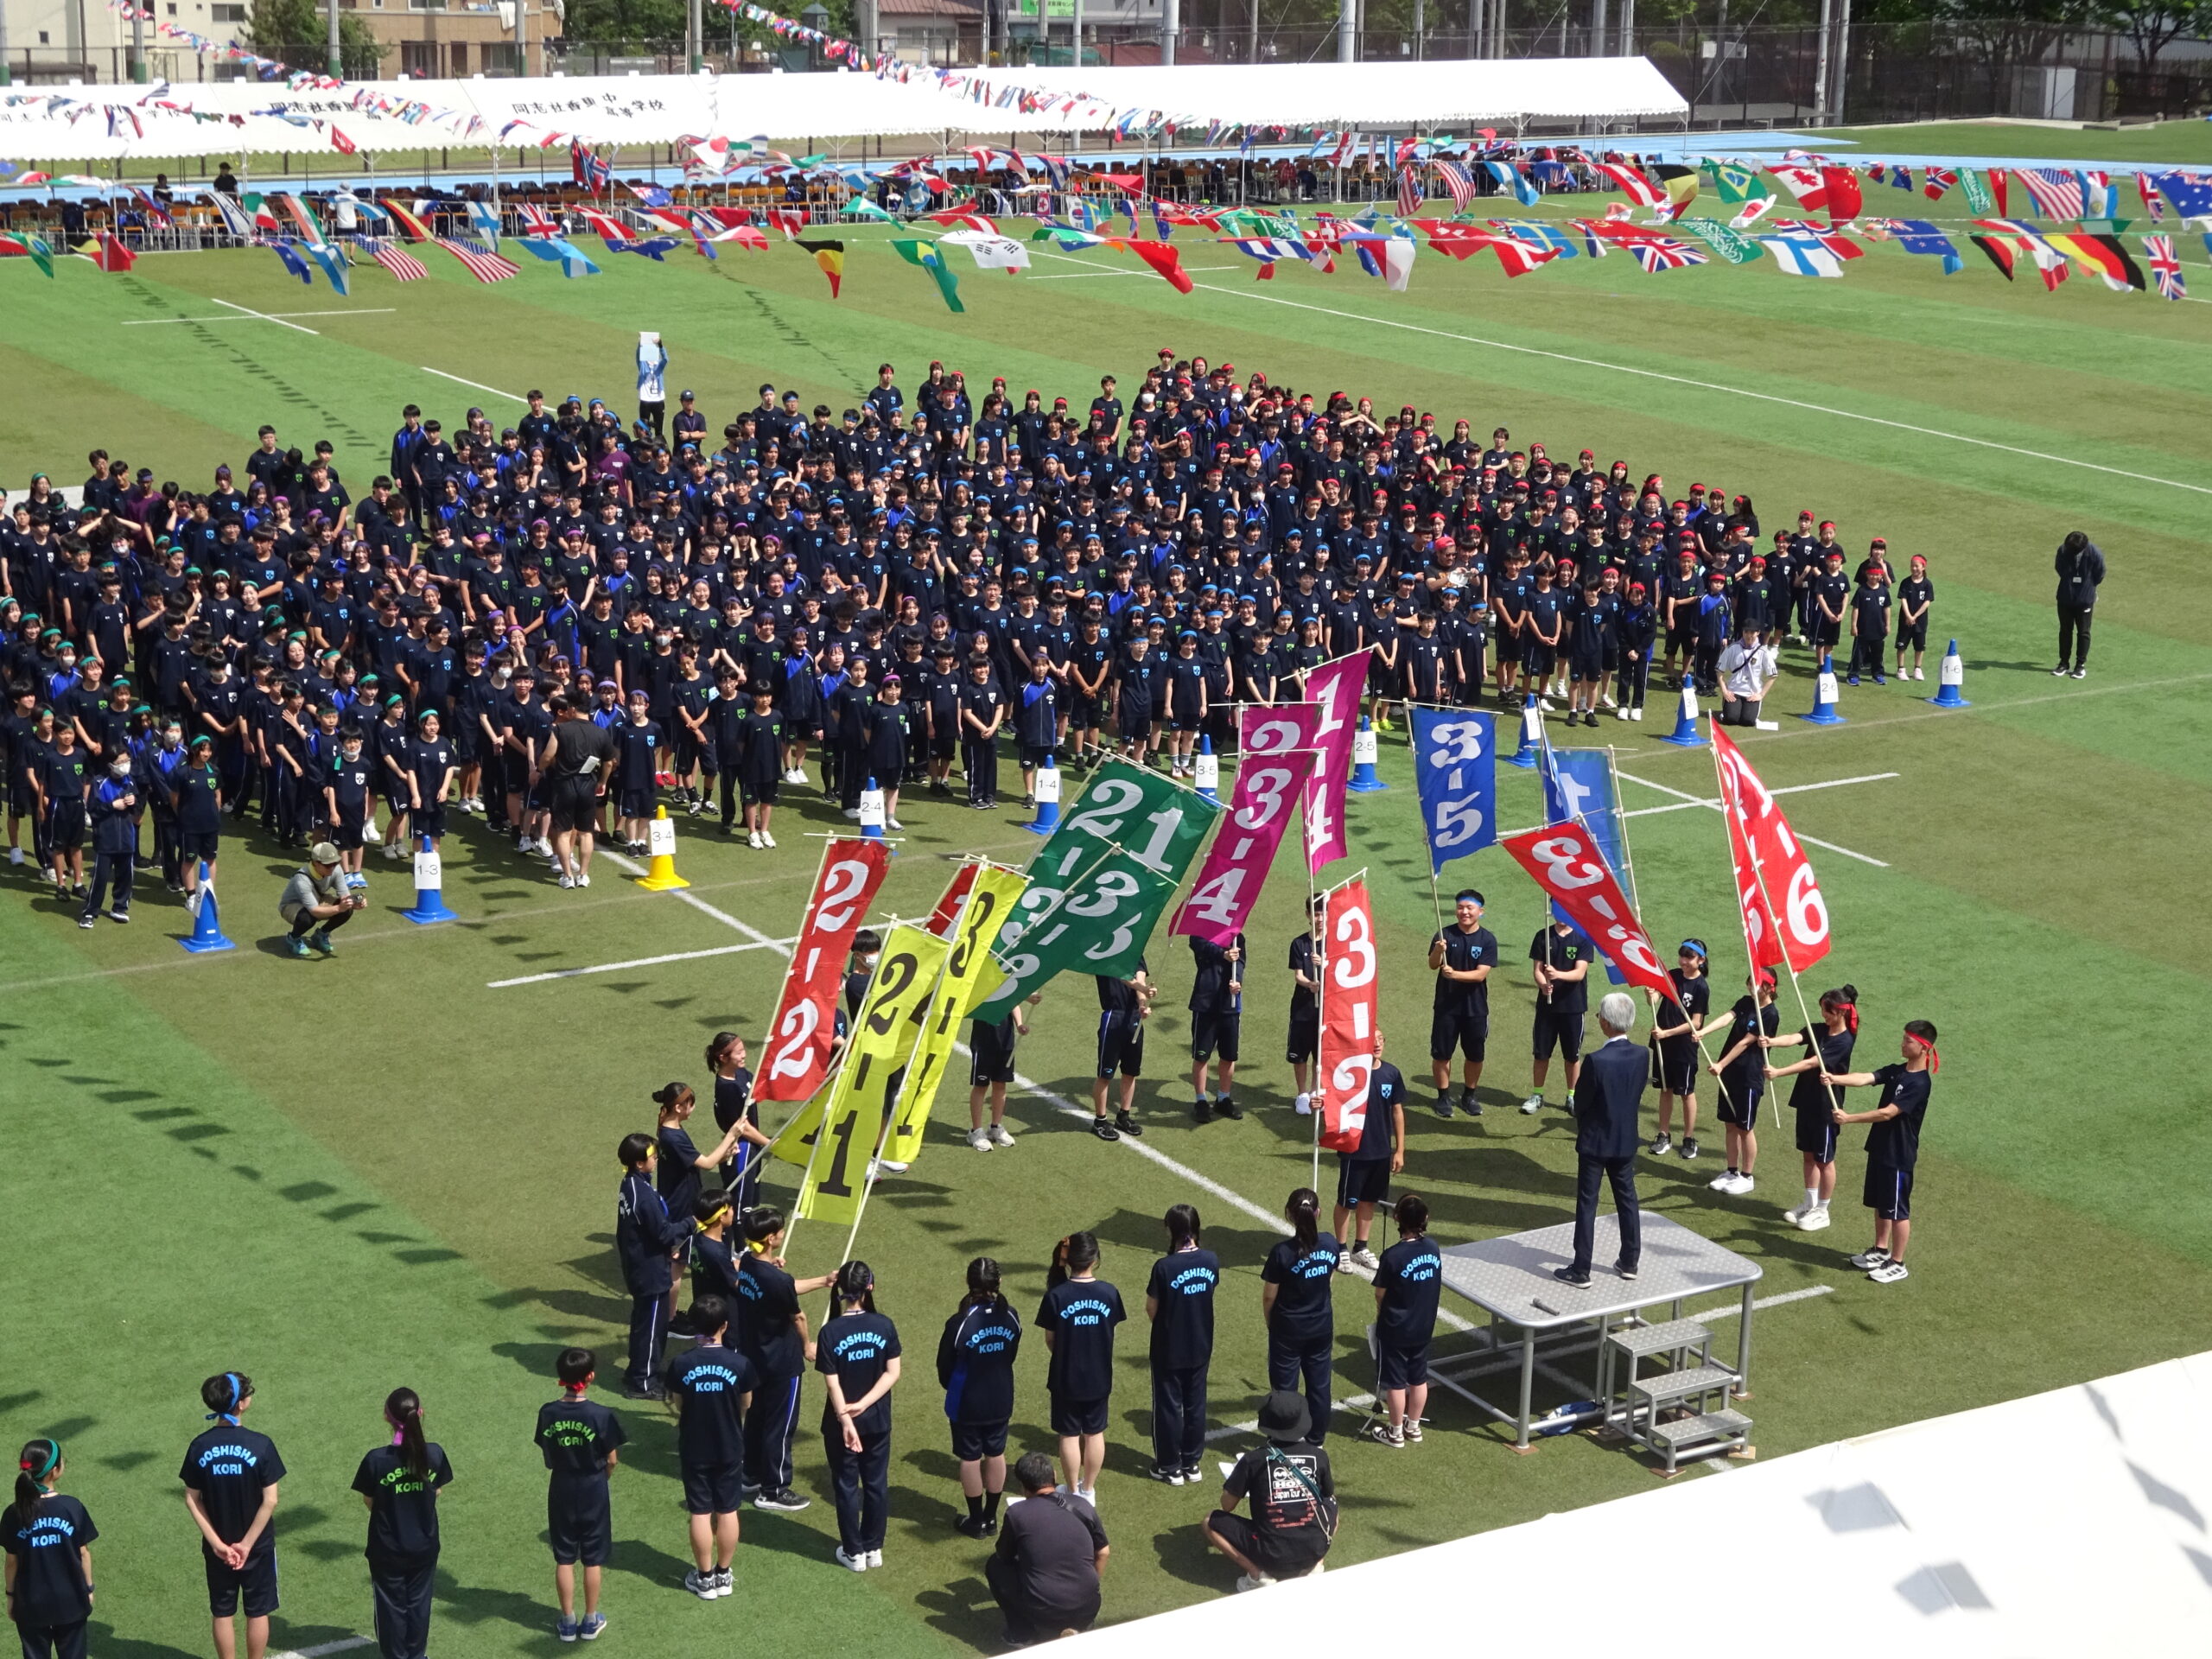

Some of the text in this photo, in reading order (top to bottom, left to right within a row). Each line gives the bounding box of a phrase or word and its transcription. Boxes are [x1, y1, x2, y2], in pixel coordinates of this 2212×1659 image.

[1944, 664, 1961, 674] 1-6
[1356, 741, 1375, 752] 2-5
[1197, 765, 1217, 775] 3-5
[1039, 779, 1057, 789] 1-4
[1429, 721, 1484, 849] 3-5
[861, 802, 882, 812] 2-4
[652, 830, 672, 842] 3-4
[1188, 768, 1294, 926] 3-4
[417, 864, 439, 875] 1-3
[769, 860, 869, 1081] 2-2
[1334, 906, 1376, 1133] 3-2
[817, 952, 918, 1198] 2-1
[1305, 1264, 1328, 1279] KORI
[1400, 1254, 1440, 1279] DOSHISHA
[1170, 1267, 1216, 1289] DOSHISHA
[1413, 1268, 1433, 1281] KORI
[1184, 1282, 1207, 1295] KORI
[1059, 1299, 1111, 1319] DOSHISHA
[1074, 1314, 1099, 1326] KORI
[833, 1331, 887, 1357] DOSHISHA
[965, 1325, 1015, 1349] DOSHISHA
[979, 1341, 1004, 1354] KORI
[848, 1348, 874, 1363] KORI
[682, 1364, 738, 1386] DOSHISHA
[695, 1381, 723, 1393] KORI
[543, 1421, 596, 1443] DOSHISHA
[557, 1436, 583, 1447] KORI
[198, 1444, 257, 1468] DOSHISHA
[212, 1463, 242, 1475] KORI
[395, 1482, 423, 1494] KORI
[32, 1534, 61, 1548] KORI
